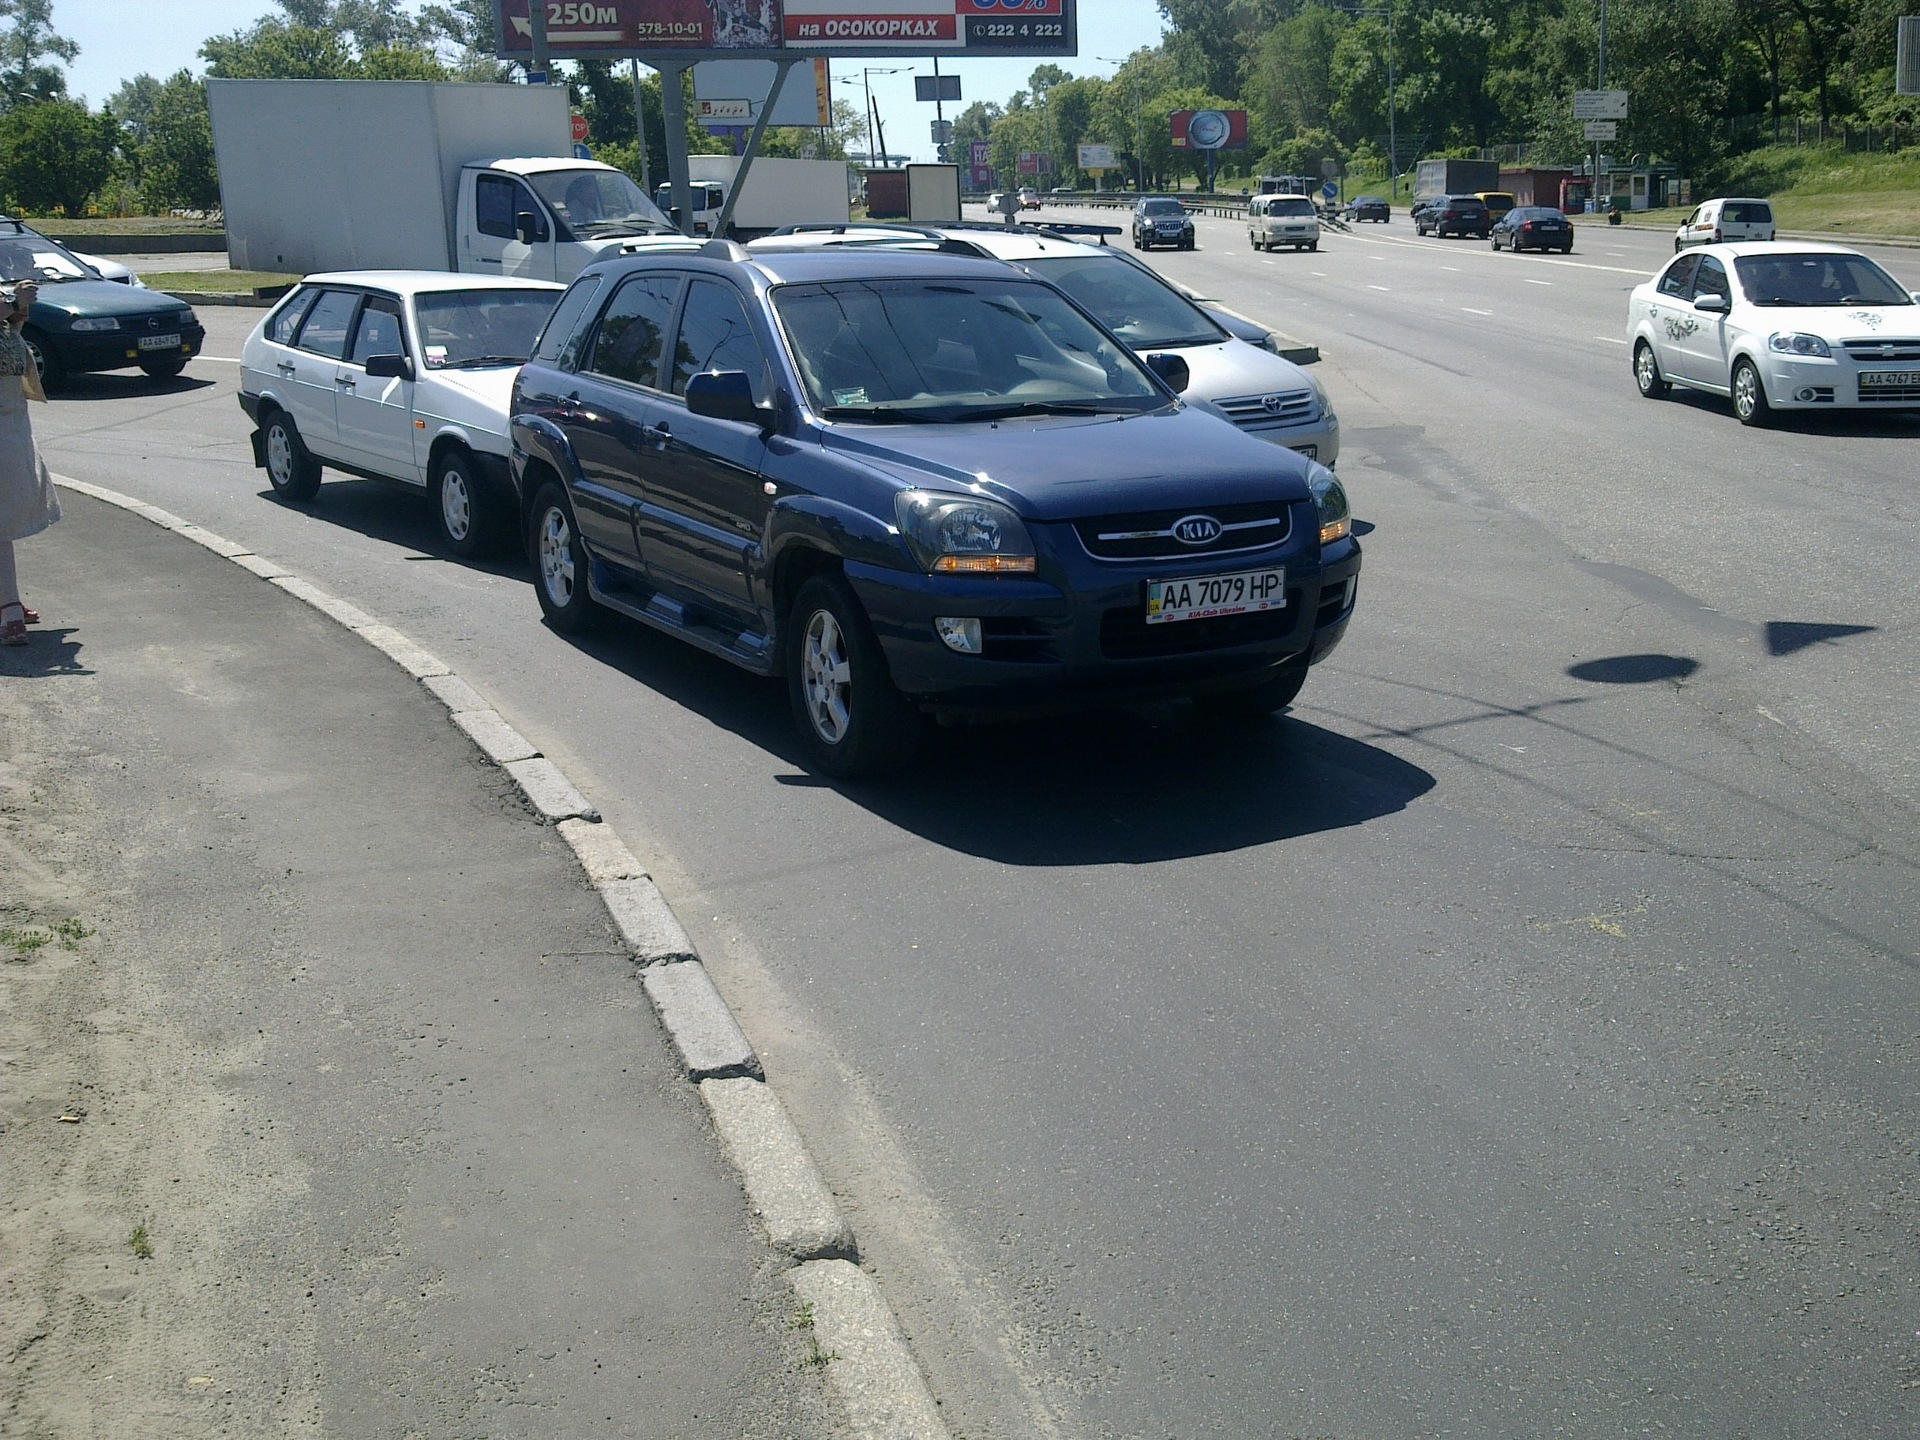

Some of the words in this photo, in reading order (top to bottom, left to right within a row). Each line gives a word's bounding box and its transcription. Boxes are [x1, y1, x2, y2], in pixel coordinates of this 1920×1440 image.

[638, 22, 703, 35] 578-10-01
[798, 24, 820, 36] на
[825, 20, 938, 36] ОСОКОРКАХ
[988, 24, 1015, 36] 222
[1019, 24, 1029, 36] 4
[1035, 24, 1062, 36] 222
[1869, 374, 1883, 384] AA
[1885, 374, 1909, 384] 4767
[1182, 522, 1216, 539] KIA
[1162, 584, 1192, 610] AA
[1198, 578, 1244, 606] 7079
[1250, 574, 1279, 600] HP
[1219, 605, 1246, 615] Ukraine
